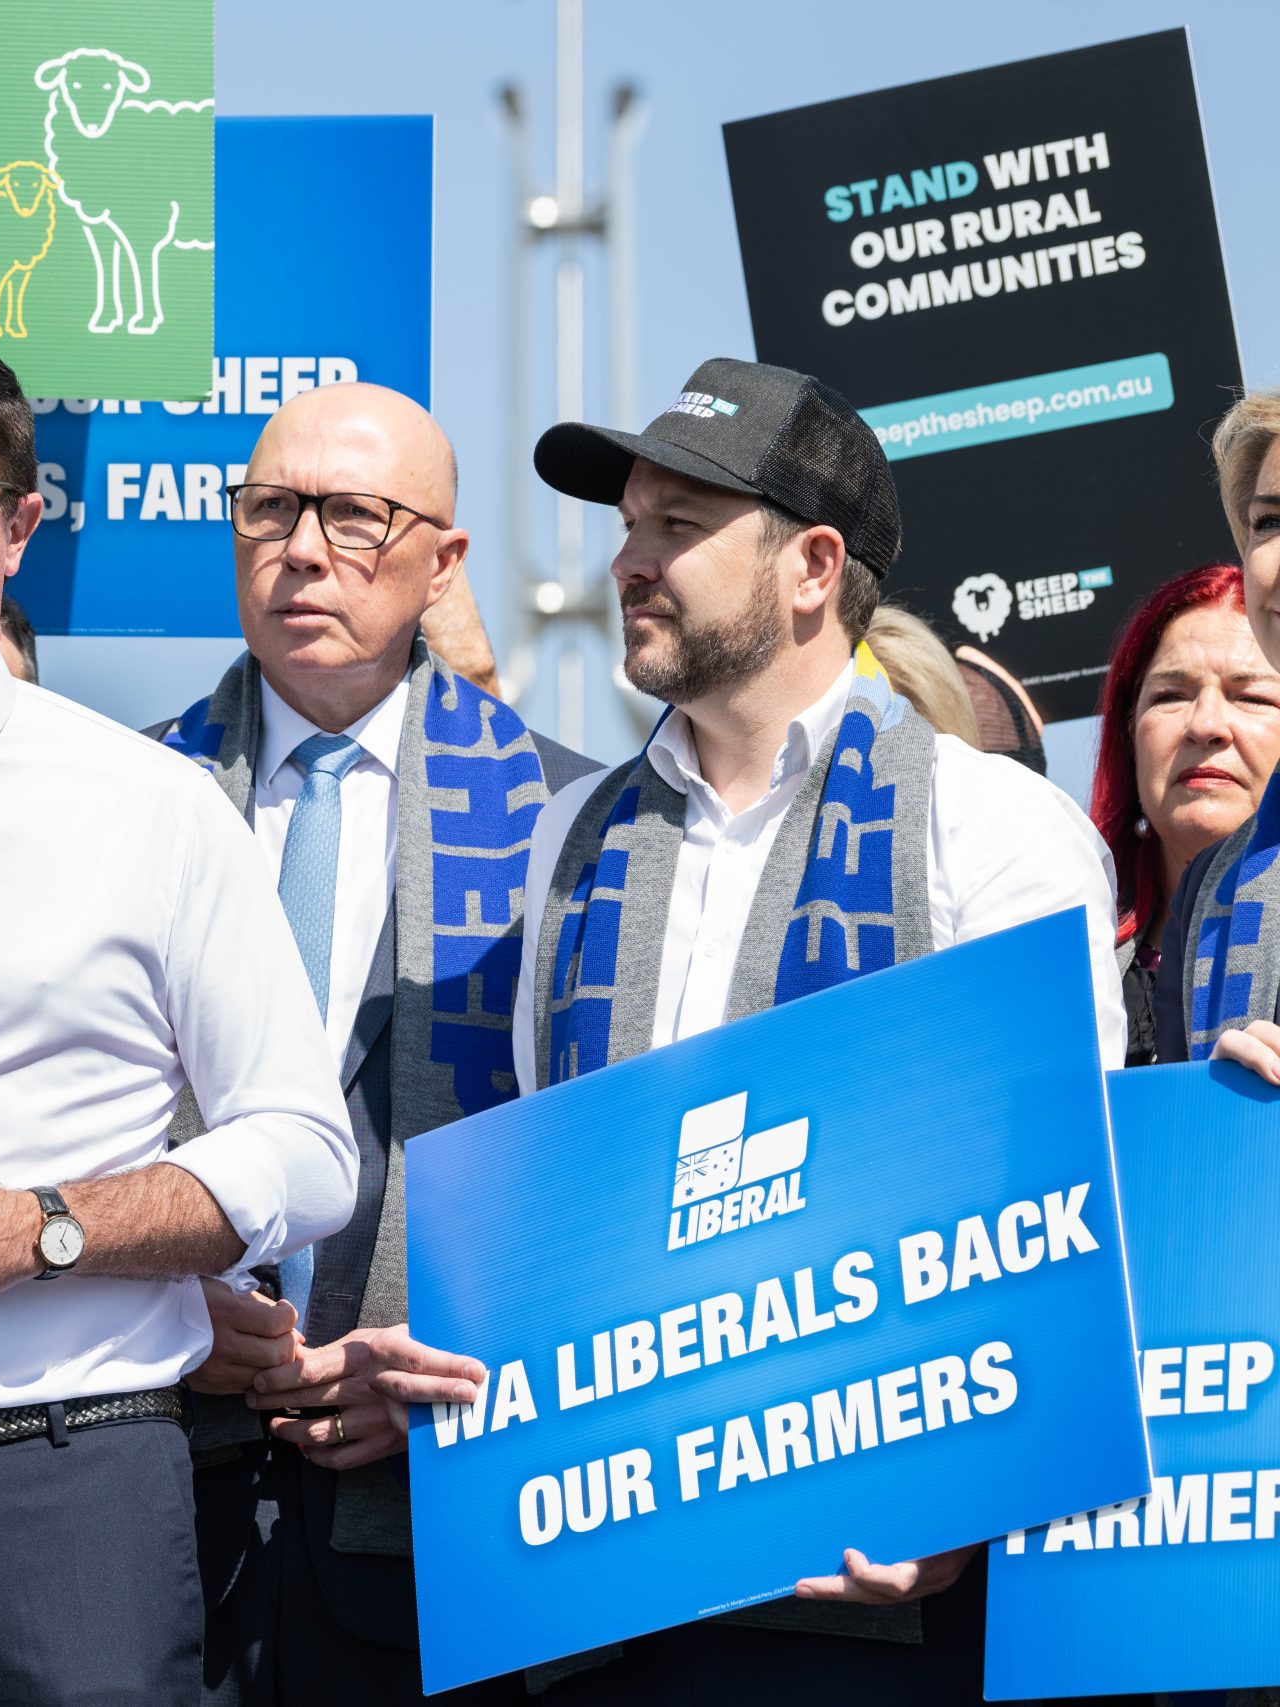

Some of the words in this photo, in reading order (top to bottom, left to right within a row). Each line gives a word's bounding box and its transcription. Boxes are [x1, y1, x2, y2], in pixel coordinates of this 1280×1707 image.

[824, 160, 979, 222] STAND
[983, 131, 1110, 190] WITH
[850, 218, 947, 269] OUR
[950, 188, 1102, 251] RURAL
[822, 231, 1146, 327] COMMUNITIES
[872, 375, 1153, 448] eepthesheep.com.au
[107, 463, 247, 521] FAR
[1015, 572, 1079, 601] KEEP
[1018, 589, 1096, 620] SHEEP
[667, 1171, 806, 1251] LIBERAL
[432, 1359, 538, 1448] WA
[556, 1250, 879, 1410] LIBERALS
[898, 1182, 1100, 1305] BACK
[1134, 1341, 1275, 1417] EEP
[518, 1449, 657, 1546] OUR
[676, 1340, 1018, 1503] FARMERS
